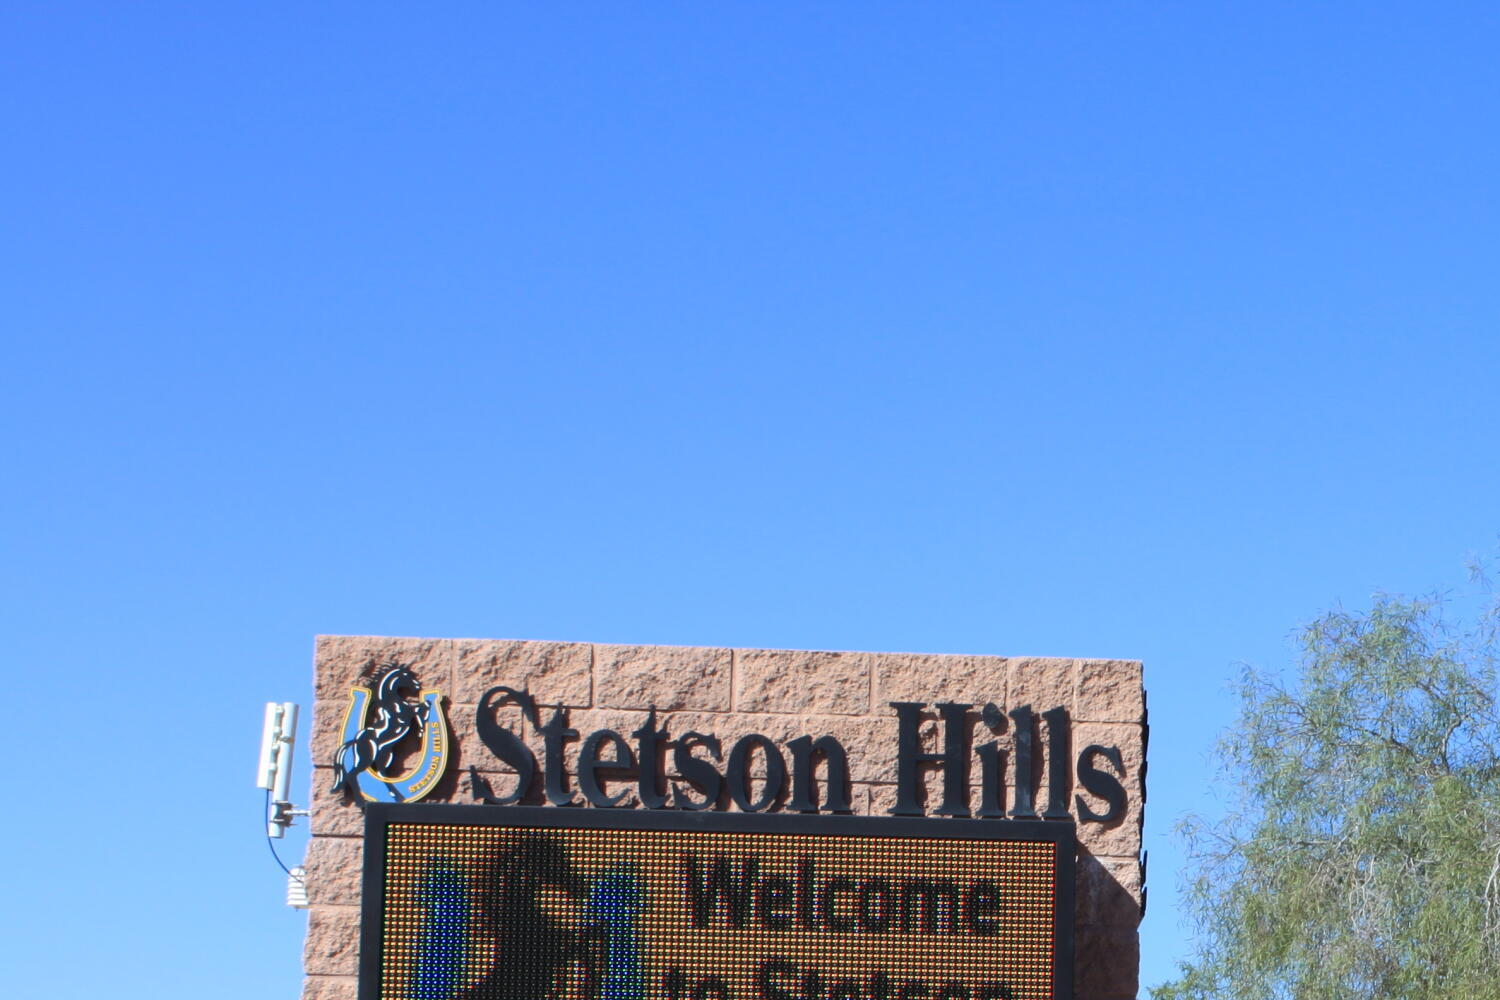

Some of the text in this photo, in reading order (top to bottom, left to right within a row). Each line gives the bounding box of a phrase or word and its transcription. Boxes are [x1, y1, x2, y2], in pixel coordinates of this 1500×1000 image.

[432, 722, 441, 753] HILLS
[470, 685, 1128, 824] Stetson Hills
[680, 852, 1001, 938] Welcome
